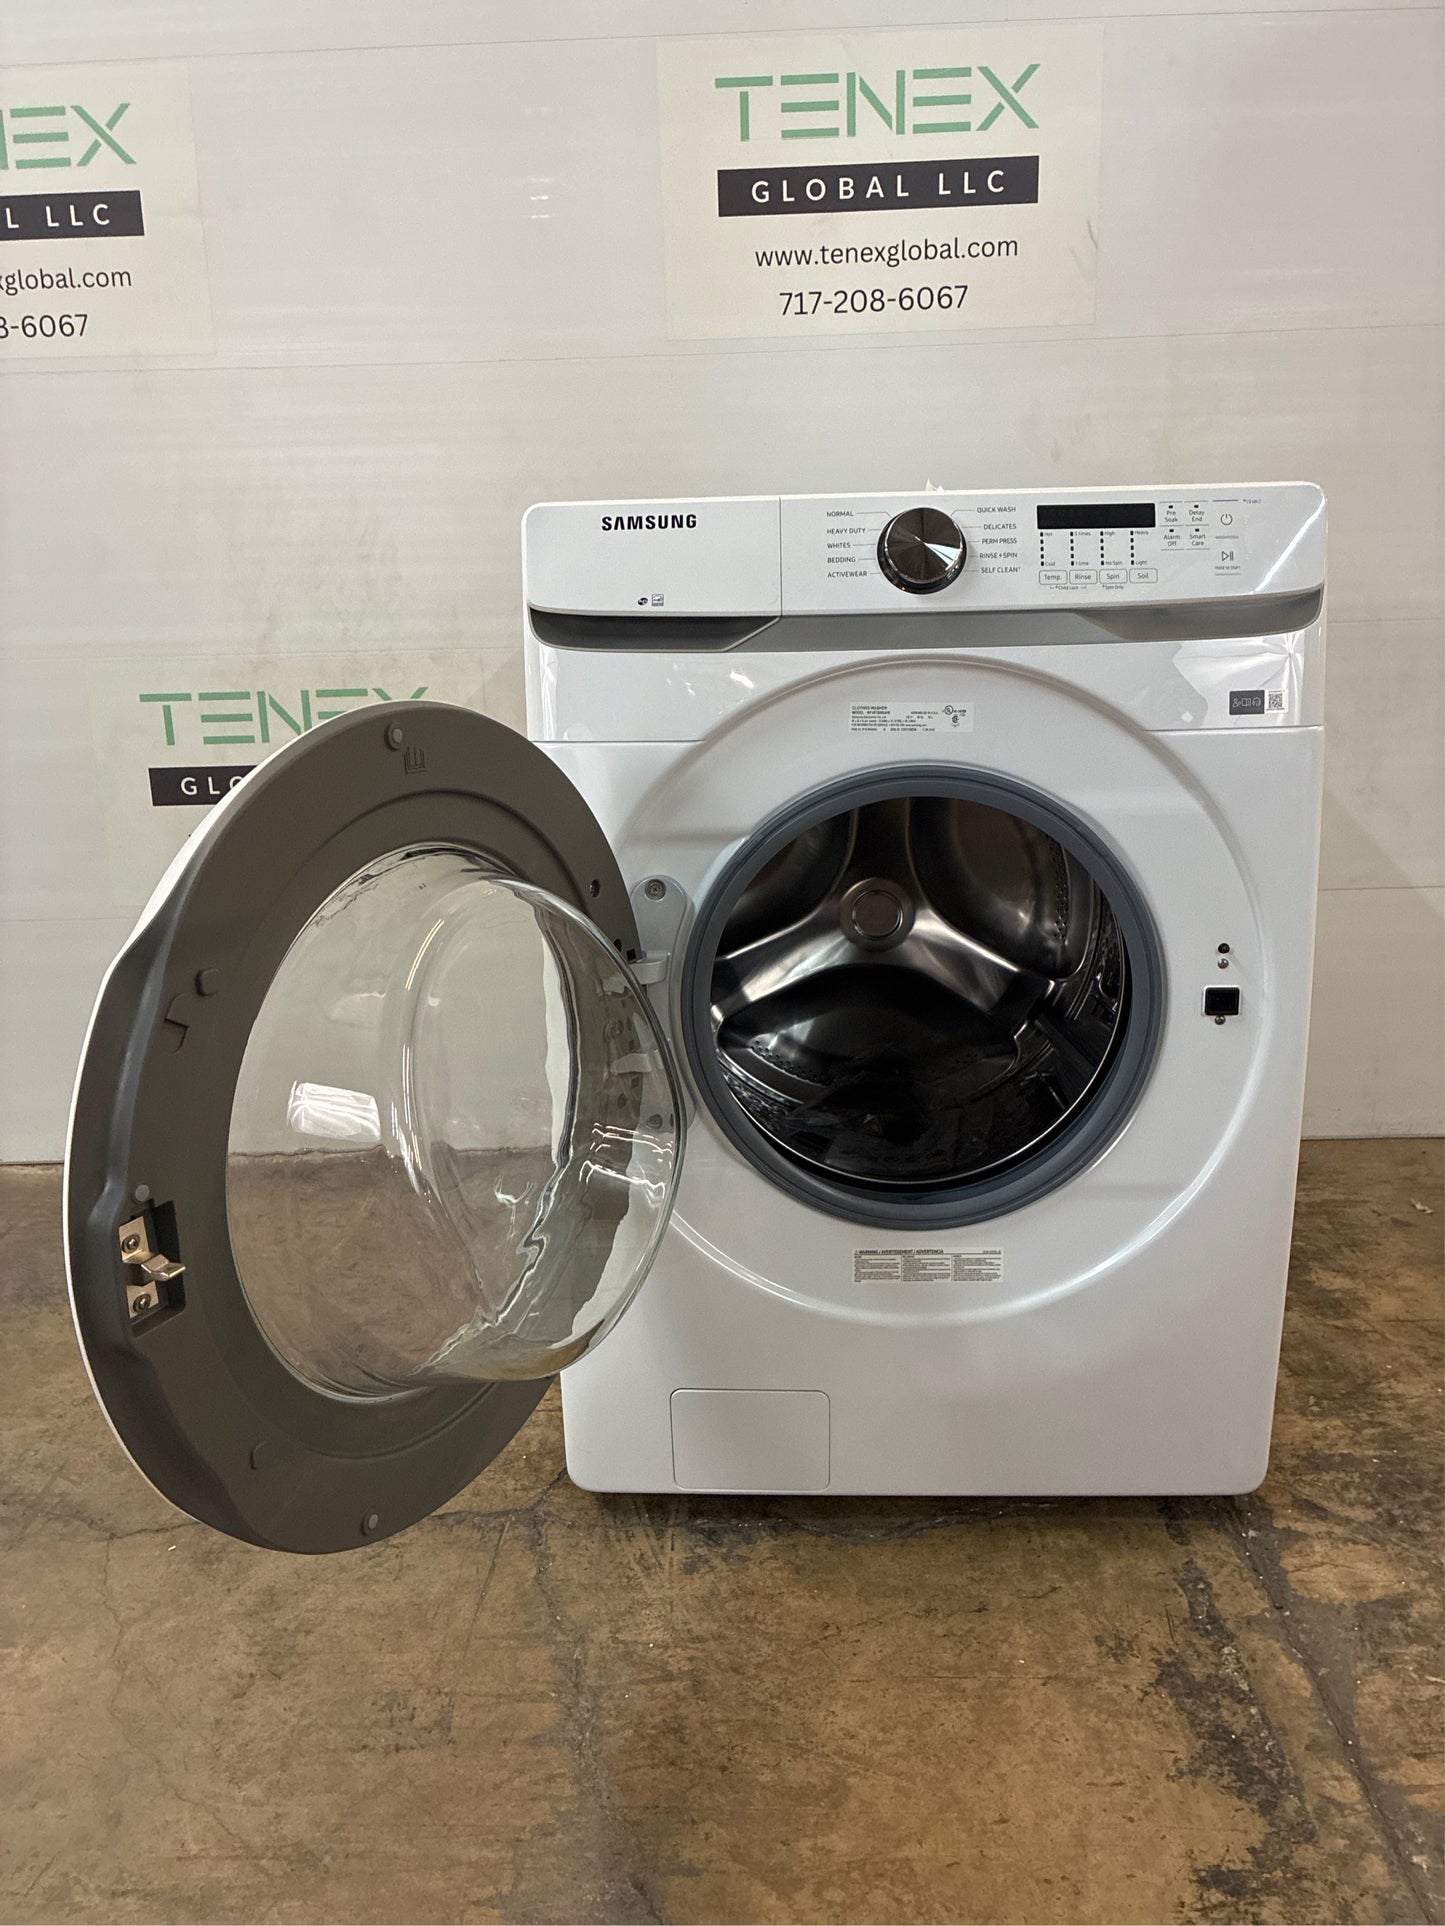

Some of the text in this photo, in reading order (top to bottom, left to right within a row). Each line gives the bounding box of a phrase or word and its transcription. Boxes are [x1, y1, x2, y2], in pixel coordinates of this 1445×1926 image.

[715, 64, 1040, 141] TENEX
[0, 103, 136, 170] EX
[751, 169, 1005, 203] GLOBAL LLC
[46, 204, 110, 227] LLC
[755, 236, 1018, 267] www.tenexglobal.com
[779, 285, 968, 316] 717-208-6067
[601, 514, 697, 531] SAMSUNG
